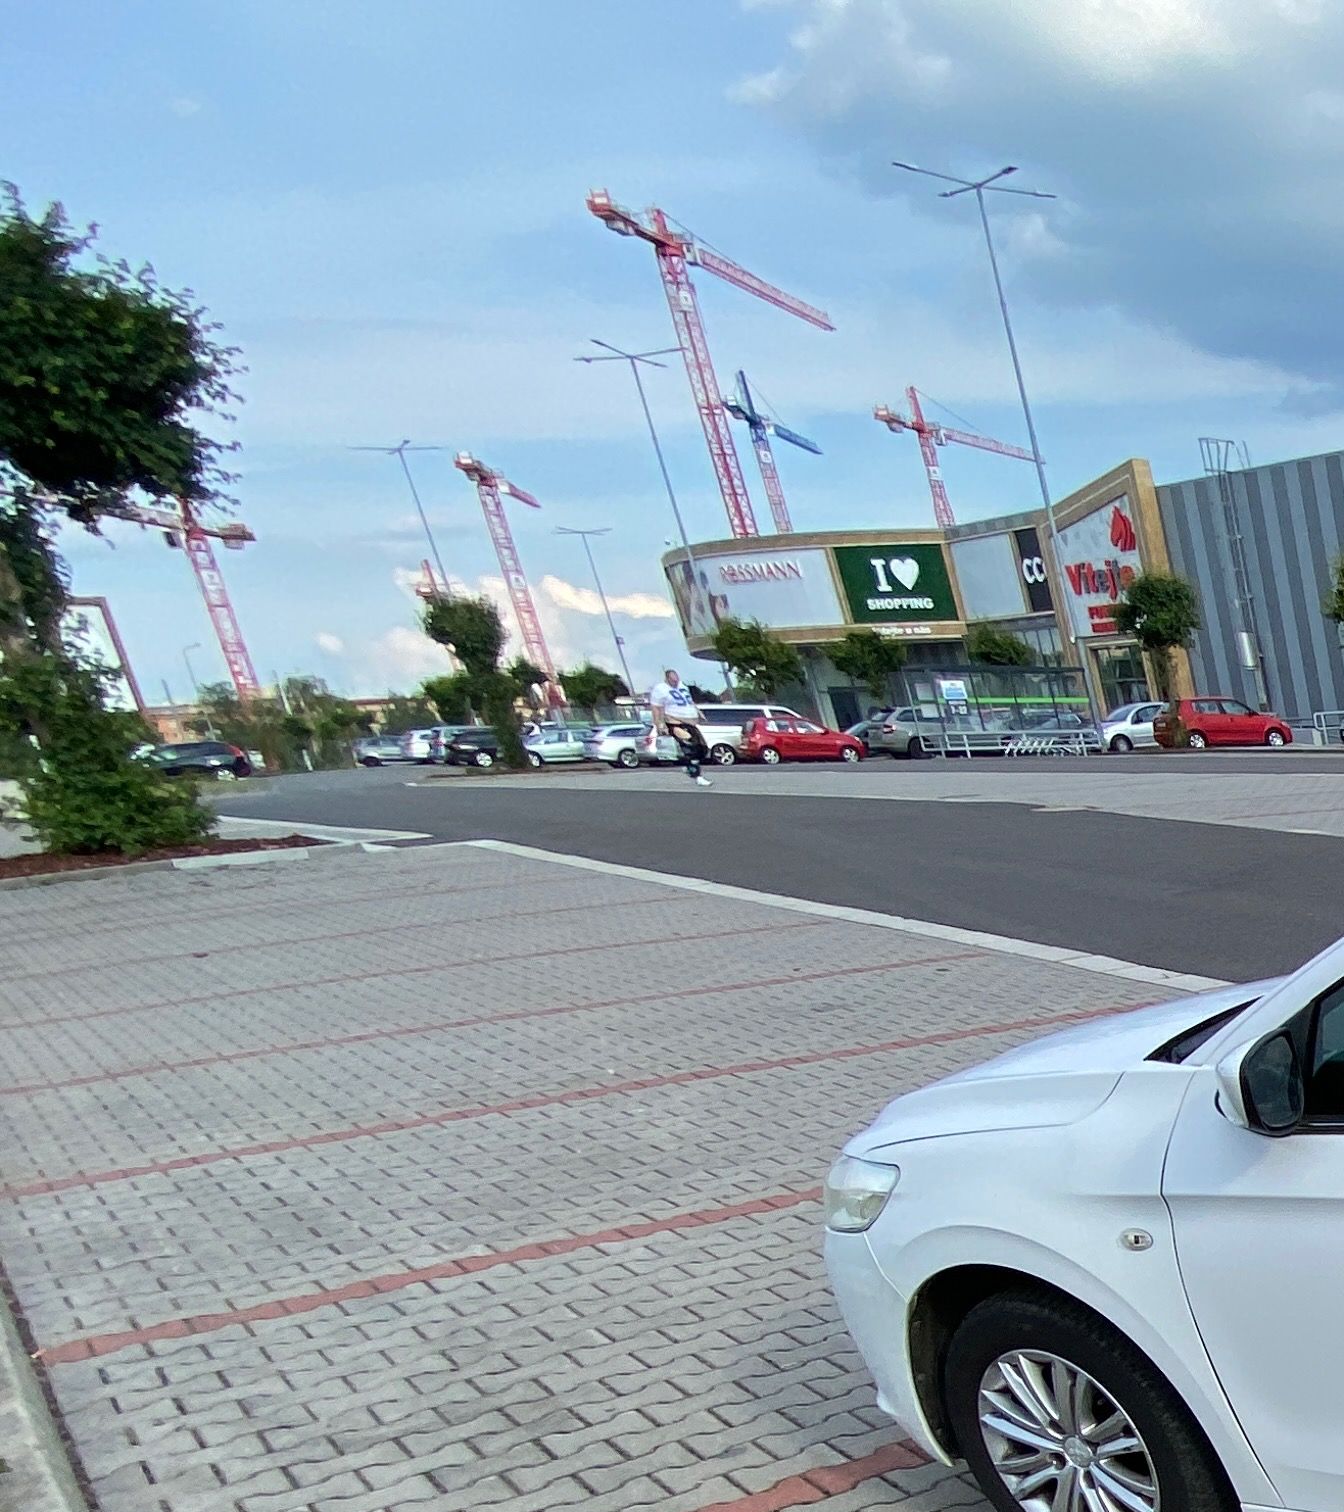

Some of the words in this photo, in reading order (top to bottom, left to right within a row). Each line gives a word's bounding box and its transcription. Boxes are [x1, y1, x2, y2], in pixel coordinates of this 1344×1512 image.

[870, 558, 893, 592] I
[1022, 556, 1047, 584] CC
[866, 597, 935, 610] SHOPPING
